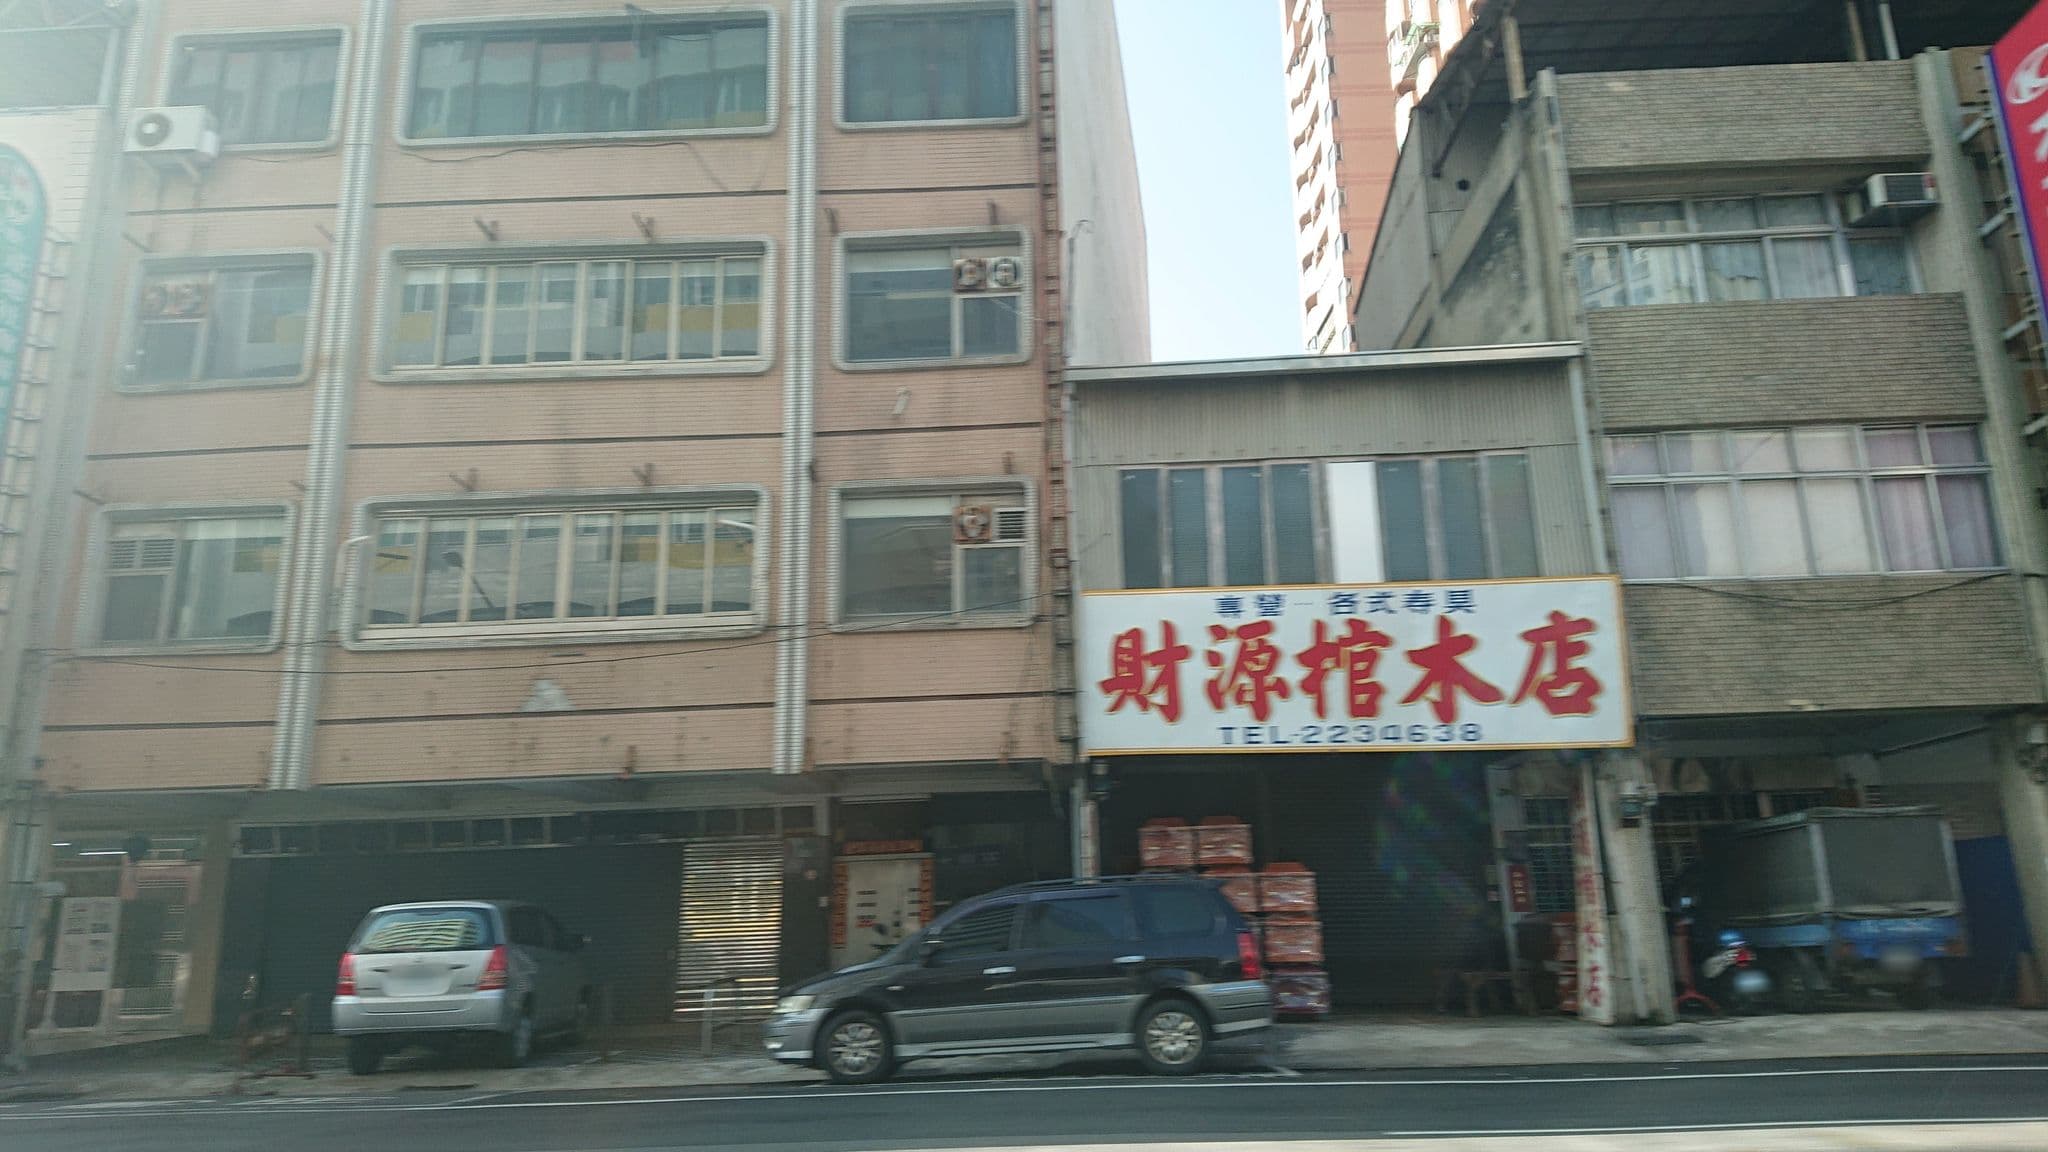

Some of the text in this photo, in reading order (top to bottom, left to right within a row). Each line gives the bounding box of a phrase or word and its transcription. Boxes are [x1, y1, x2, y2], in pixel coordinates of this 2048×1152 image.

[1099, 610, 1603, 723] 財源棺木店
